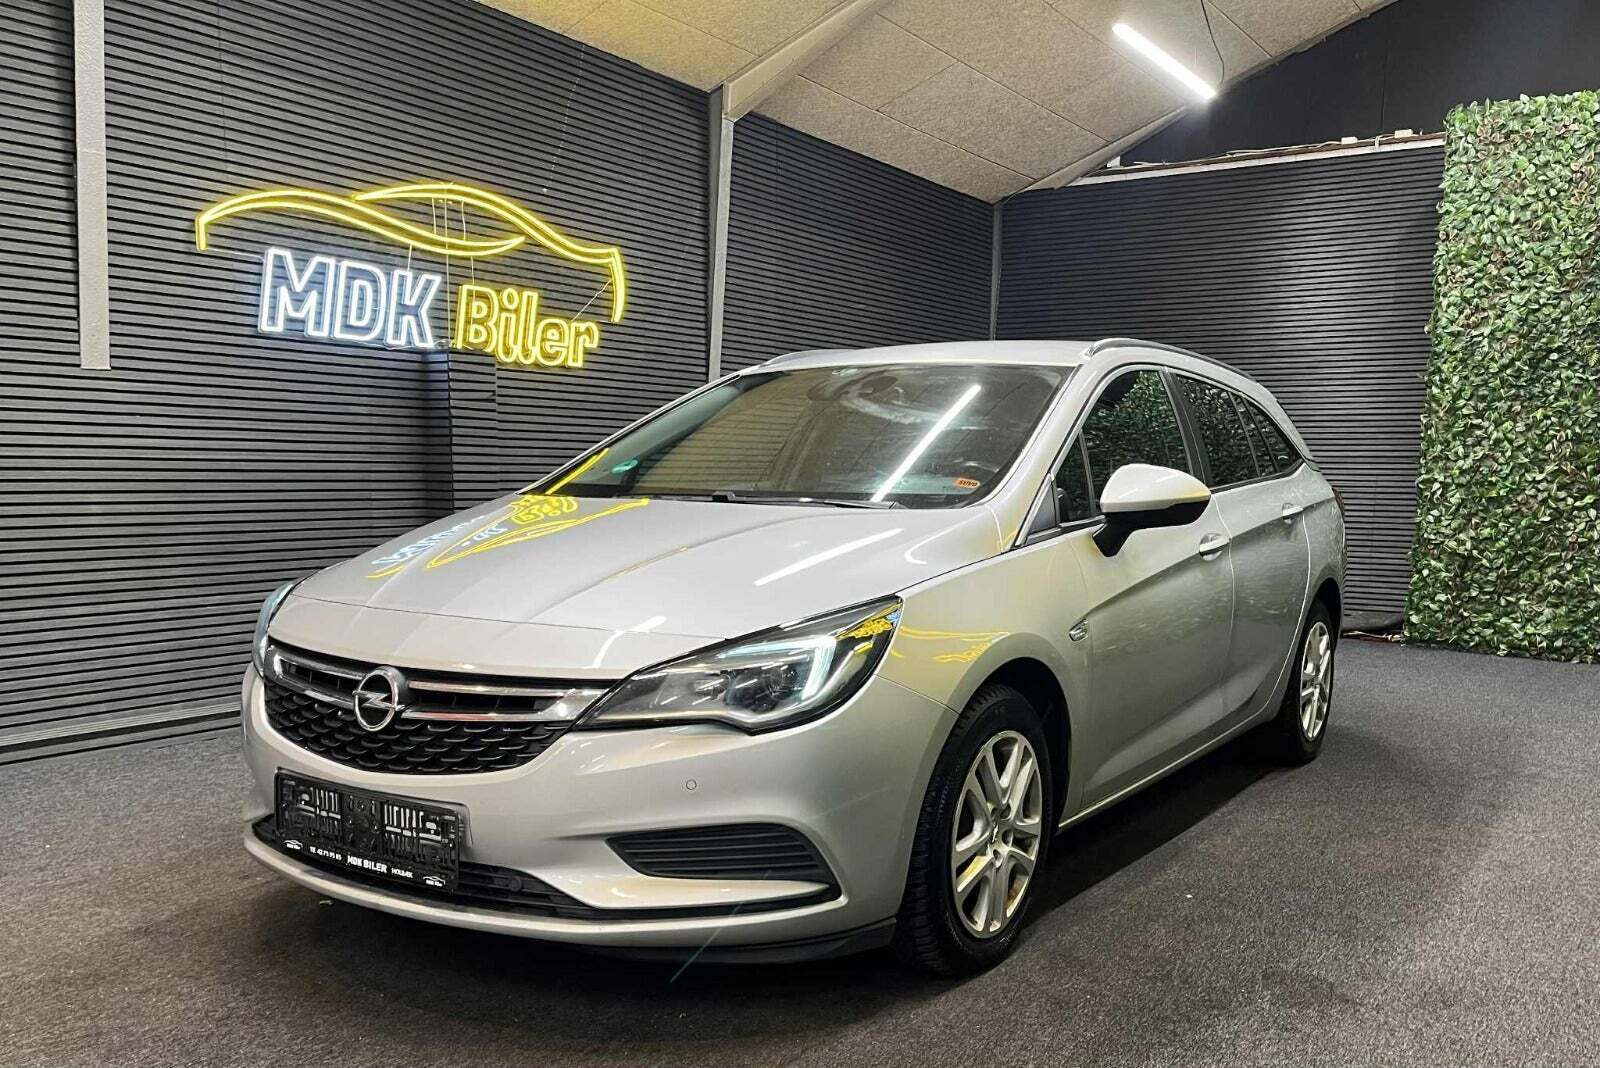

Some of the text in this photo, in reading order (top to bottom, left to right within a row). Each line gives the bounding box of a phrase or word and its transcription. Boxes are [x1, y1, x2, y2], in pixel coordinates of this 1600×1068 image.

[258, 247, 600, 368] MDK Biler
[347, 855, 362, 867] MDK
[363, 859, 387, 874] BILER
